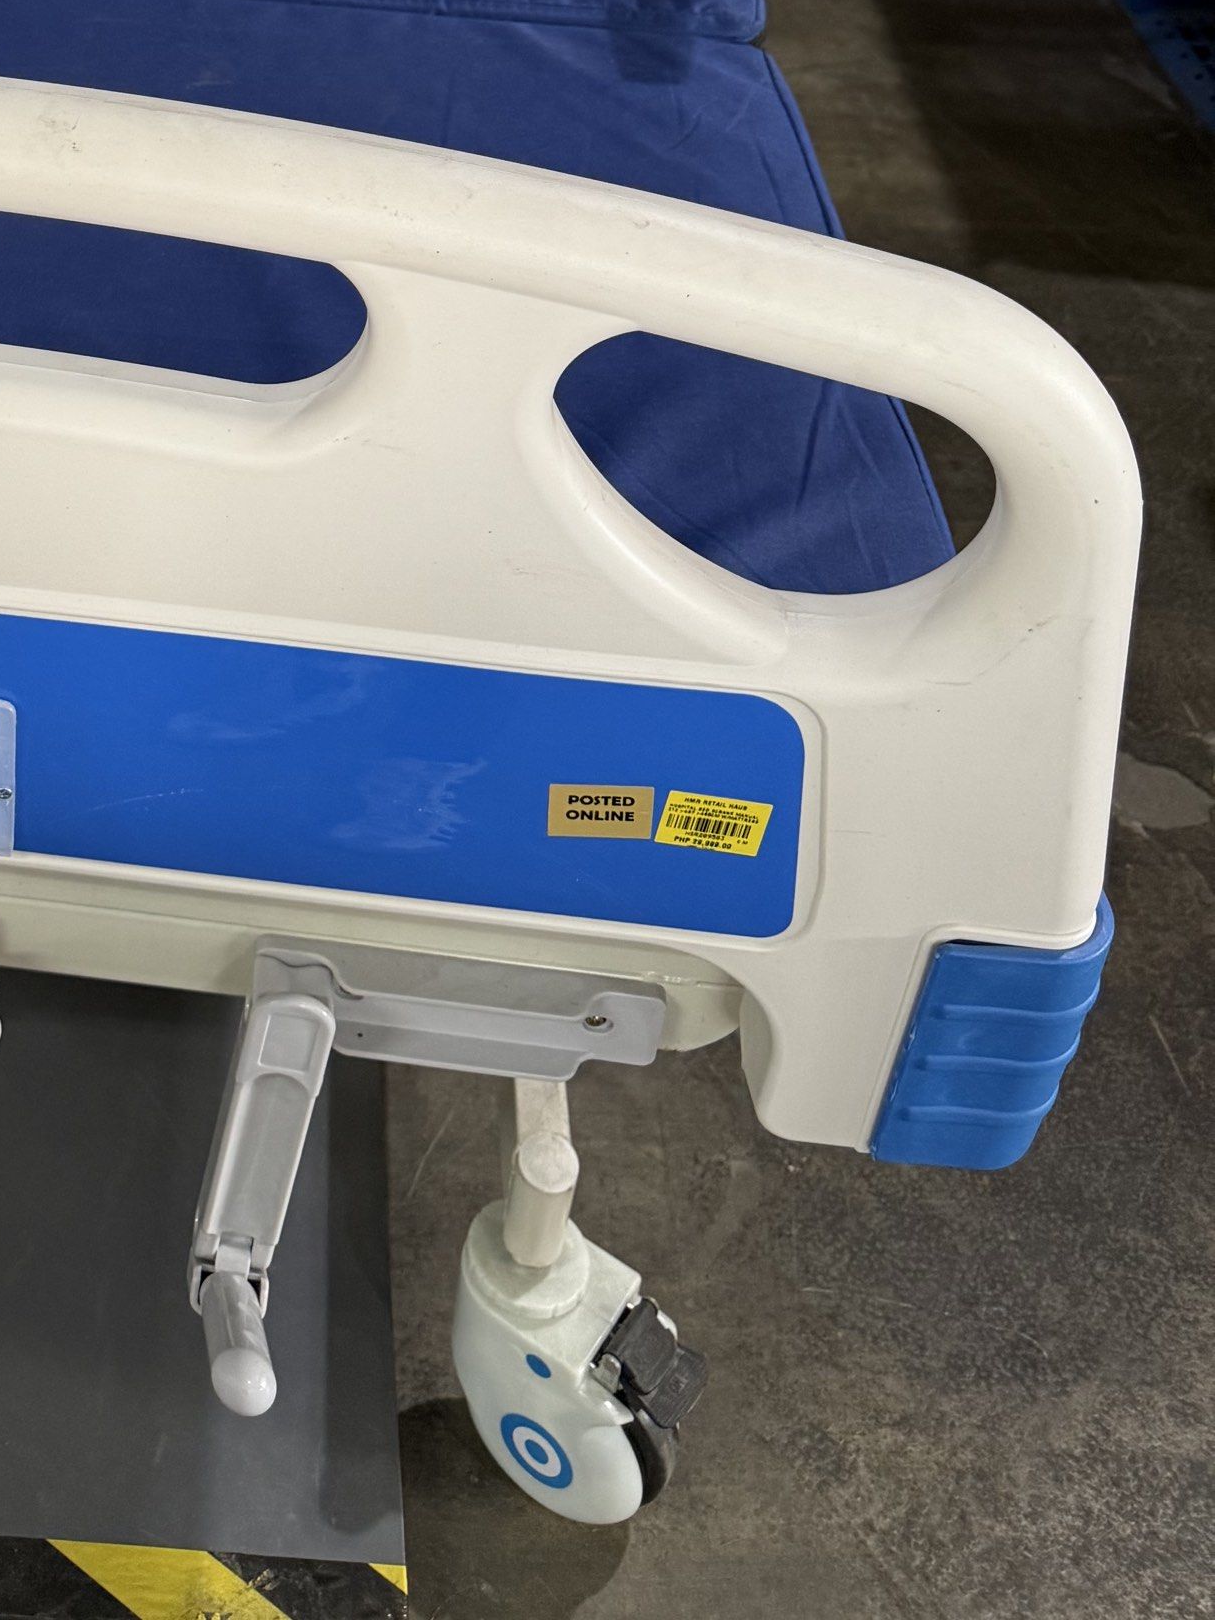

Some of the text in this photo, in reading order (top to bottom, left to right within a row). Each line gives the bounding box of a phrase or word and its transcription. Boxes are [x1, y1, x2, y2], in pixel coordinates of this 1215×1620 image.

[567, 794, 636, 807] POSTED
[566, 809, 636, 822] ONLINE
[673, 835, 691, 843] PHP
